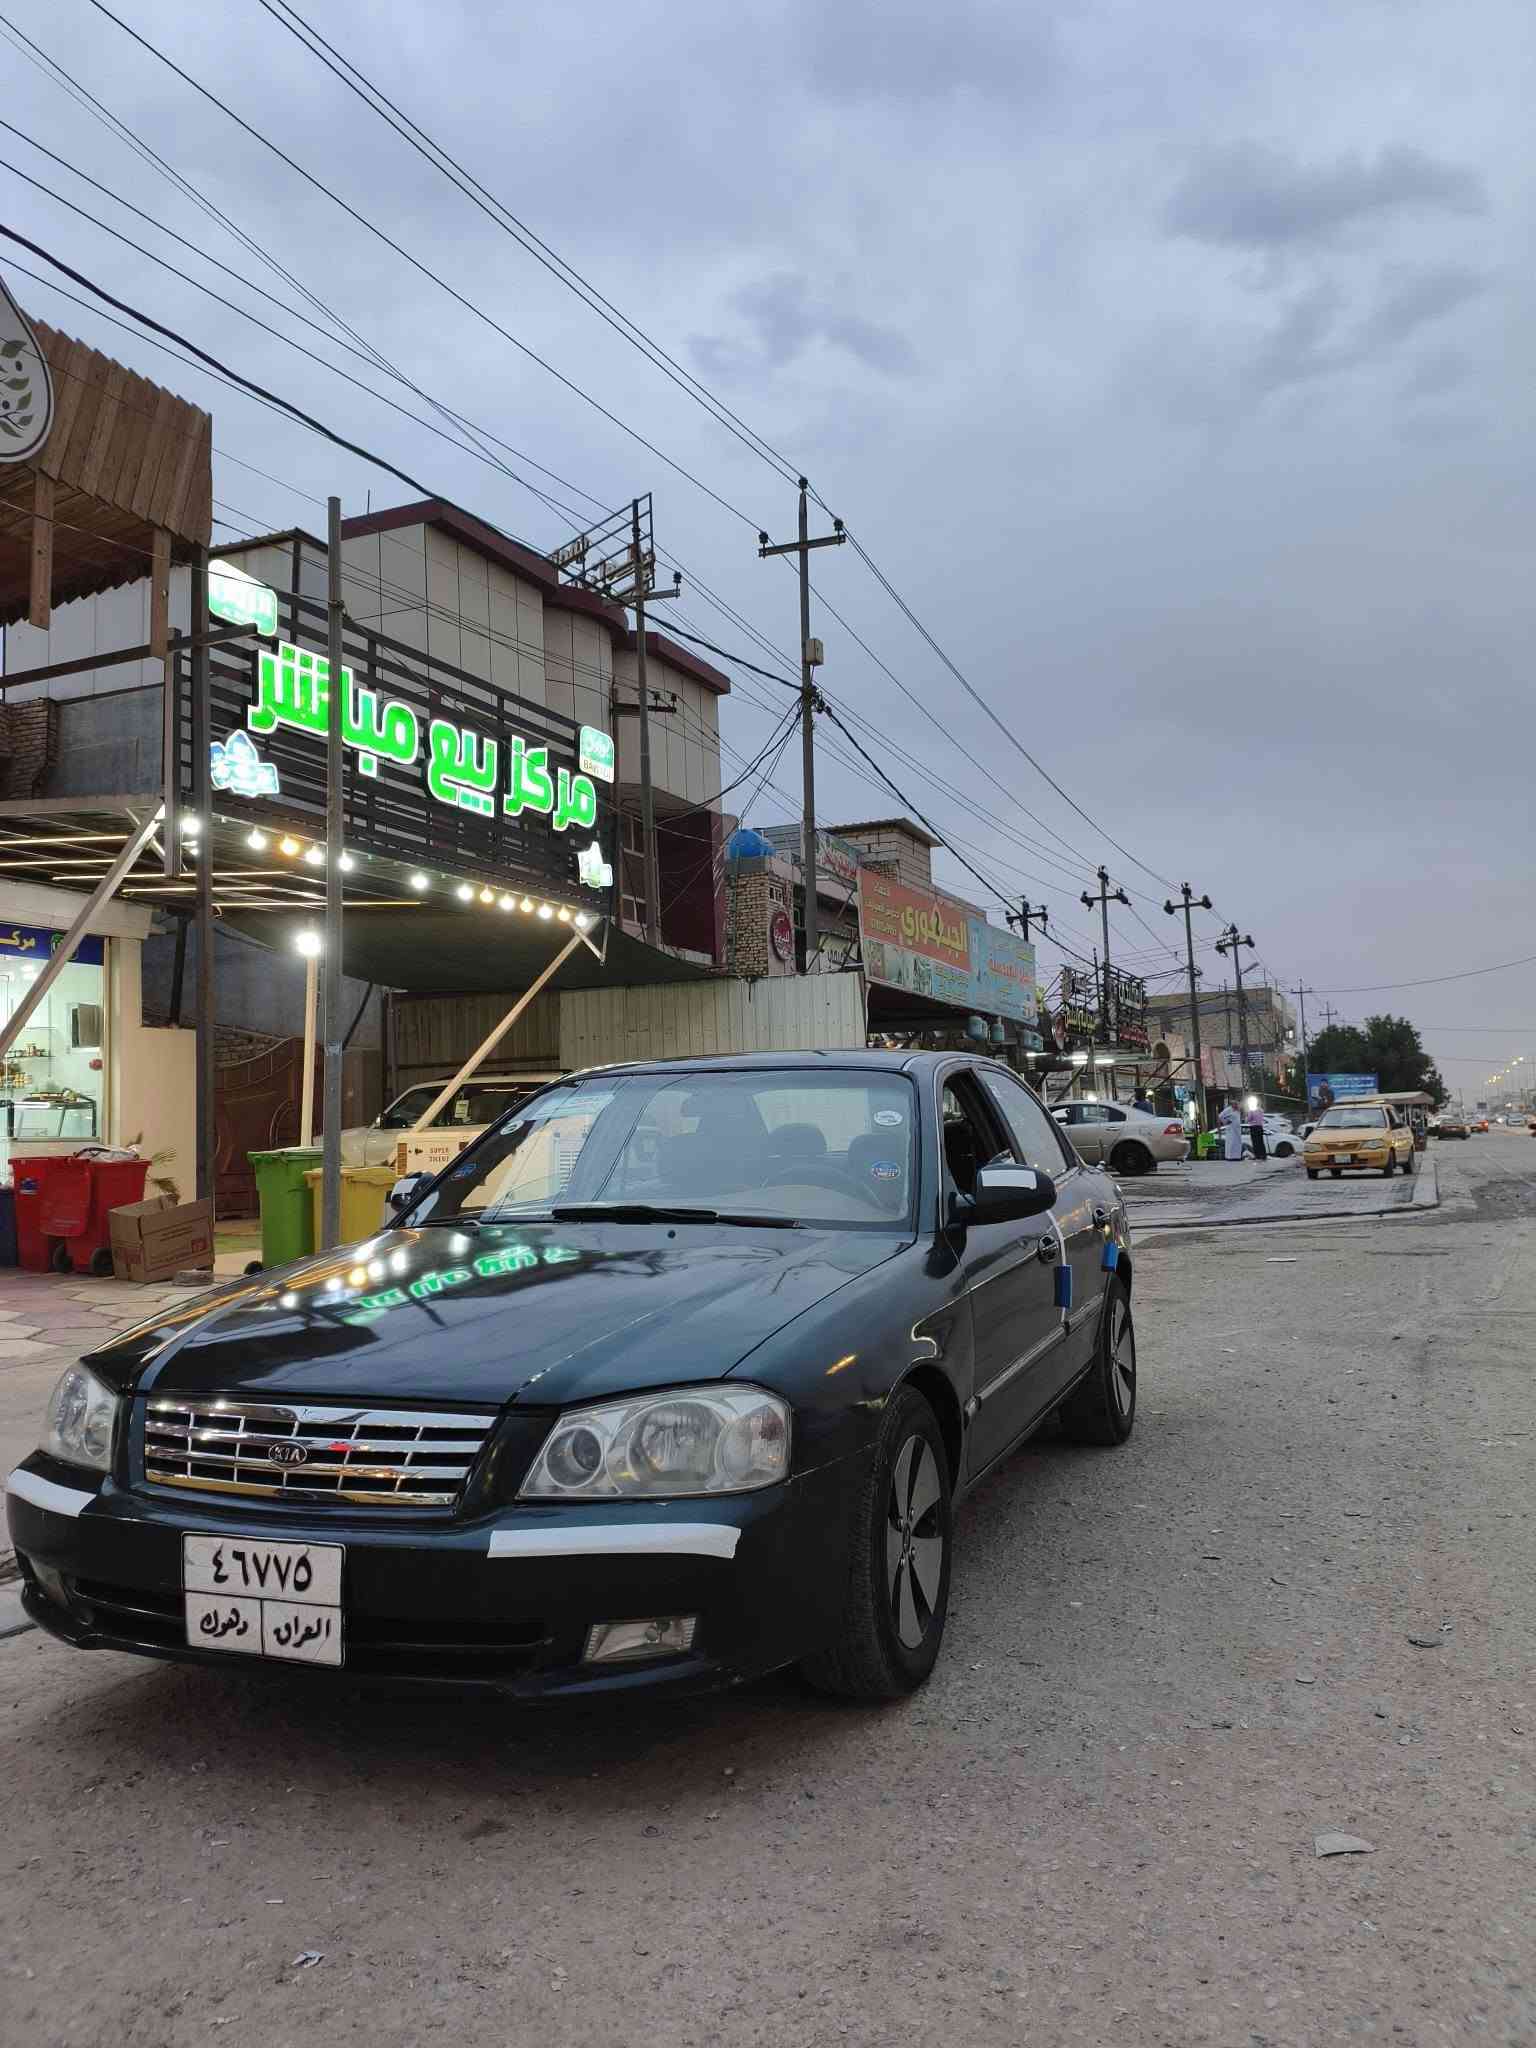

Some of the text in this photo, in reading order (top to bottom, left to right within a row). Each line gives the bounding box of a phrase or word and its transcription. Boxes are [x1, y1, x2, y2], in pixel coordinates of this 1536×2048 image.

[247, 640, 418, 778] مباشر
[428, 717, 498, 818] بيع
[503, 735, 597, 831] مركز
[212, 1543, 312, 1592] ٤٦٧٧٥
